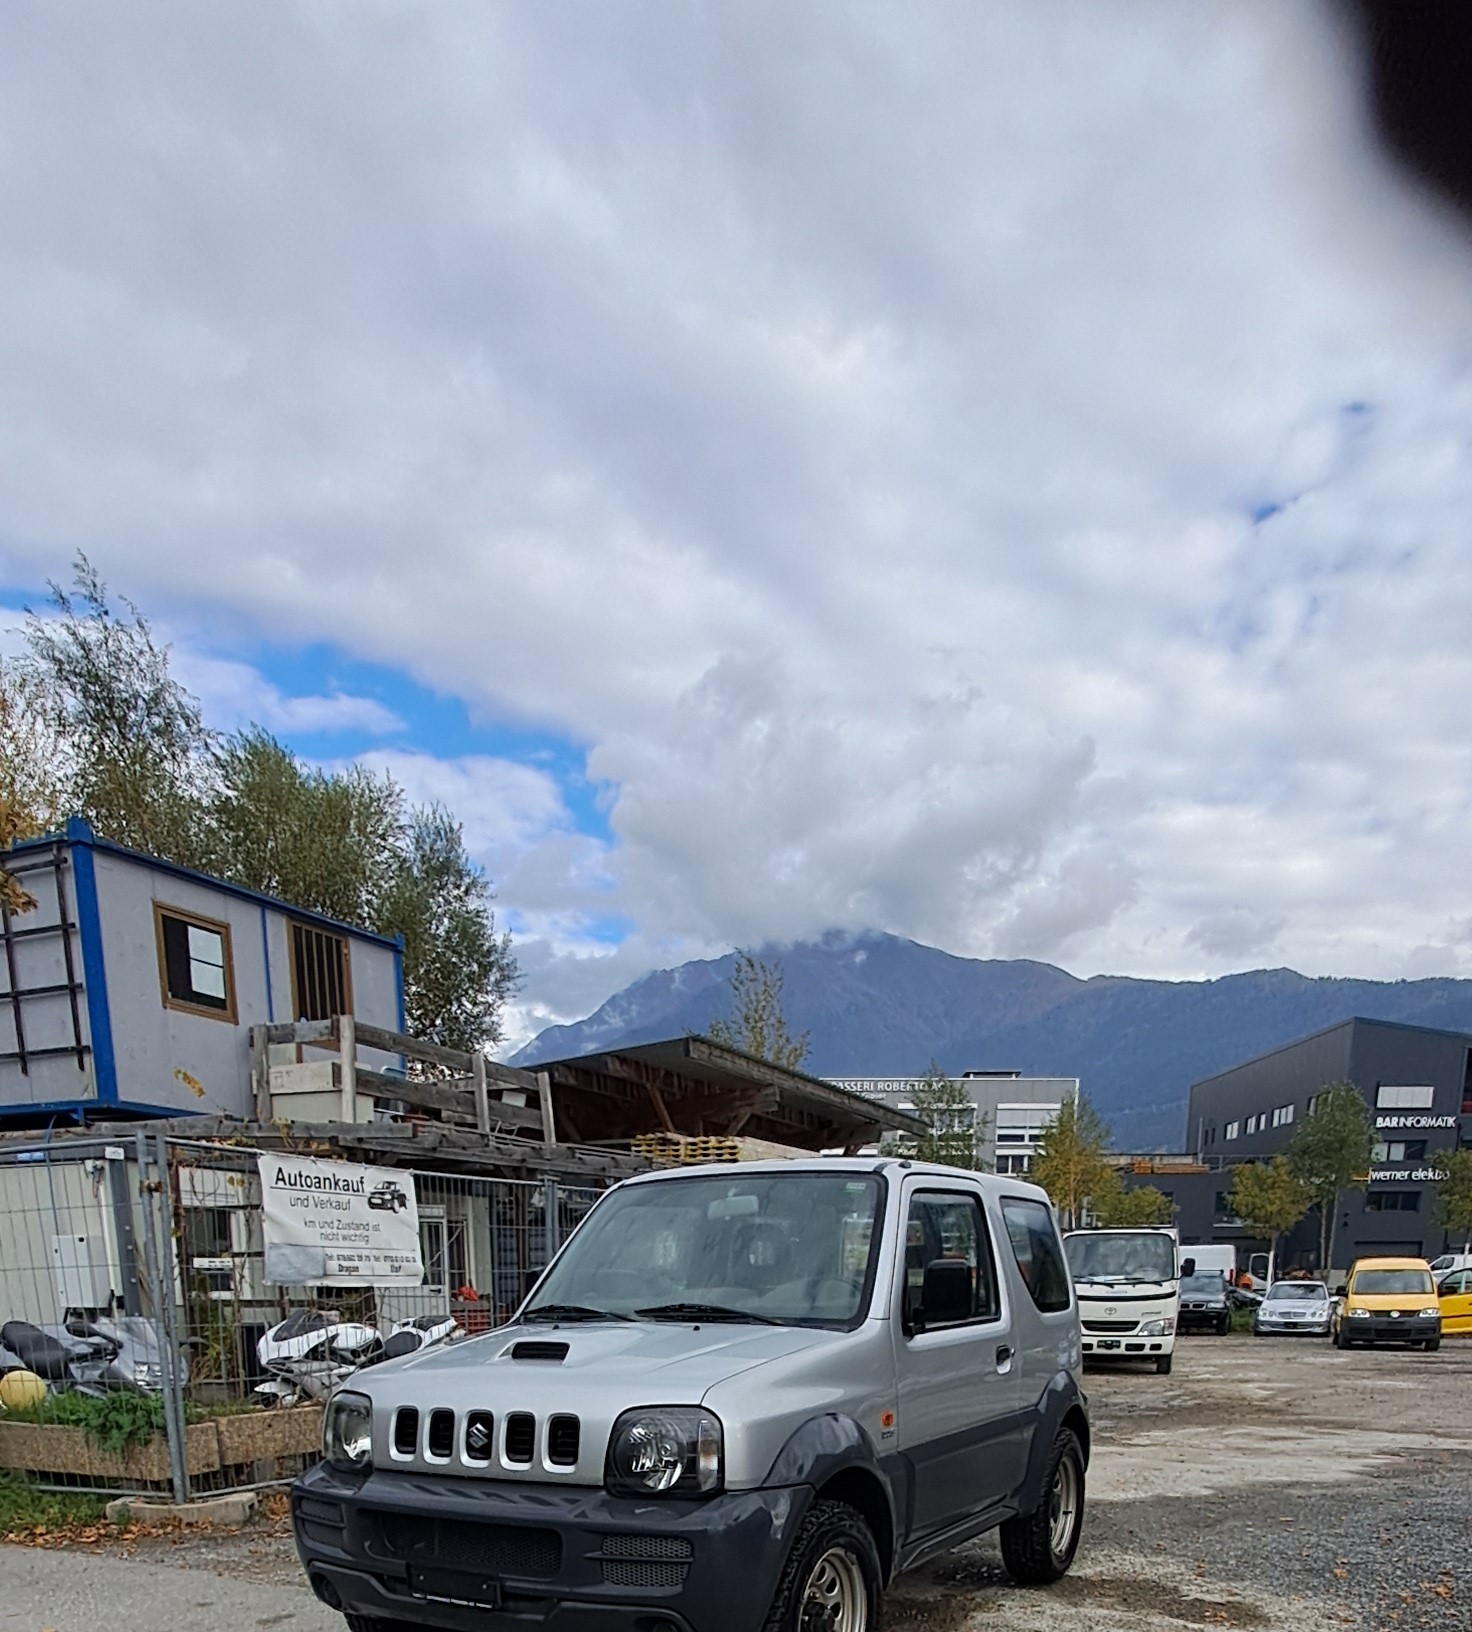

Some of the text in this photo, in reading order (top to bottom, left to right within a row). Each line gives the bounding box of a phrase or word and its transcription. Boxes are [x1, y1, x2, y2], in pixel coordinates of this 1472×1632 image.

[275, 1166, 365, 1193] Autoankauf
[1371, 1170, 1410, 1181] werner
[289, 1195, 351, 1211] und Verkauf
[303, 1217, 381, 1232] km und Zustand ist
[320, 1231, 370, 1245] nicht wichtig
